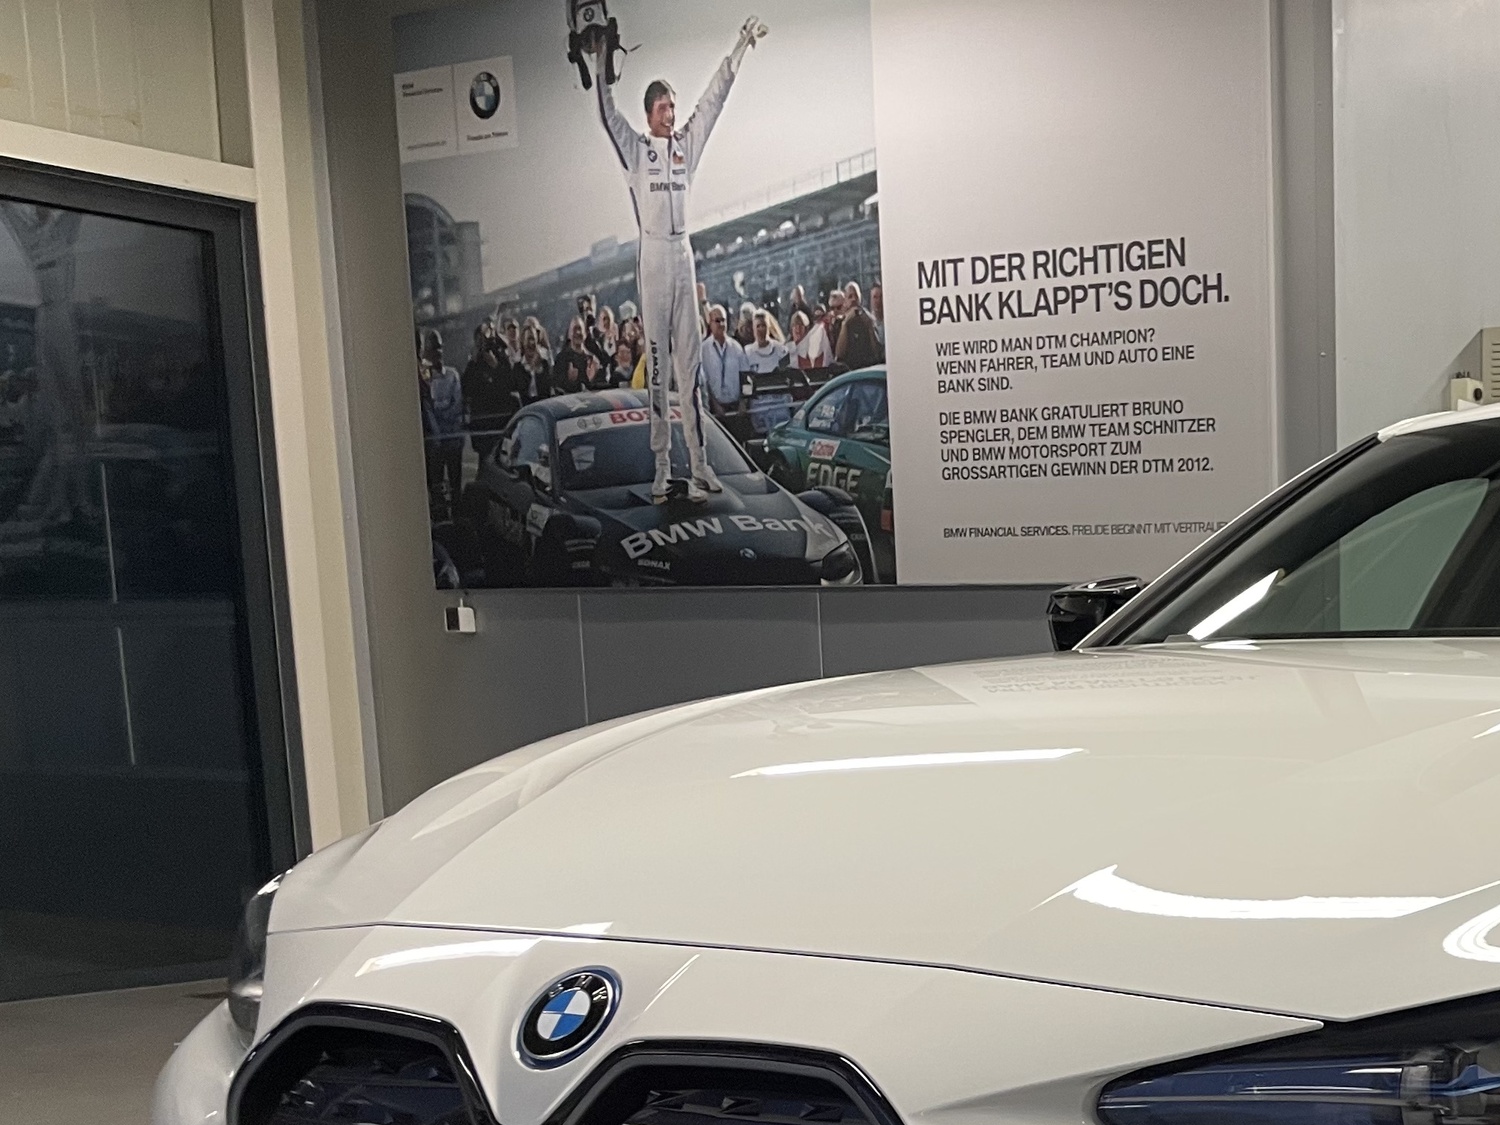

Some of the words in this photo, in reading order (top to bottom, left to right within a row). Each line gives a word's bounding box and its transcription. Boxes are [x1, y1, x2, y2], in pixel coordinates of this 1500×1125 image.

[918, 257, 964, 289] MIT
[971, 253, 1026, 285] DER
[1033, 237, 1185, 280] RICHTIGEN
[919, 292, 993, 325] BANK
[998, 280, 1133, 320] KLAPPT'S
[1139, 273, 1229, 309] DOCH.
[936, 342, 960, 357] WIE
[963, 339, 998, 355] WIRD
[1001, 336, 1032, 352] MAN
[1036, 334, 1066, 350] DTM
[1070, 328, 1155, 347] CHAMPION?
[937, 359, 976, 375] WENN
[980, 356, 1037, 373] FAHRER,
[1041, 353, 1080, 368] TEAM
[1084, 351, 1115, 366] UND
[1118, 348, 1158, 364] AUTO
[1162, 345, 1195, 361] EINE
[938, 378, 975, 394] BANK
[978, 376, 1013, 391] SIND.
[939, 411, 961, 426] DIE
[964, 410, 997, 424] BMW
[1000, 407, 1038, 423] BANK
[1041, 403, 1129, 420] GRATULIERT
[1133, 399, 1184, 416] BRUNO
[940, 428, 1015, 445] SPENGLER,
[1018, 426, 1047, 441] DEM
[1051, 424, 1086, 439] BMW
[1089, 422, 1130, 437] TEAM
[1133, 418, 1216, 435] SCHNITZER
[941, 448, 969, 463] UND
[972, 447, 1005, 461] BMW
[1009, 442, 1107, 460] MOTORSPORT
[1110, 440, 1142, 455] ZUM
[942, 463, 1047, 480] GROSSARTIGEN
[1051, 461, 1106, 476] GEWINN
[1110, 459, 1138, 475] DER
[1143, 458, 1174, 473] DTM
[1178, 457, 1214, 472] 2012.
[620, 516, 724, 560] BMW
[728, 514, 830, 535] Bank
[943, 527, 967, 538] BMW
[969, 526, 1019, 537] FINANCIAL
[1020, 525, 1071, 536] SERVICES.
[1072, 524, 1109, 535] FREUDE
[1111, 523, 1153, 535] BEGINNT
[1154, 522, 1171, 534] MIT
